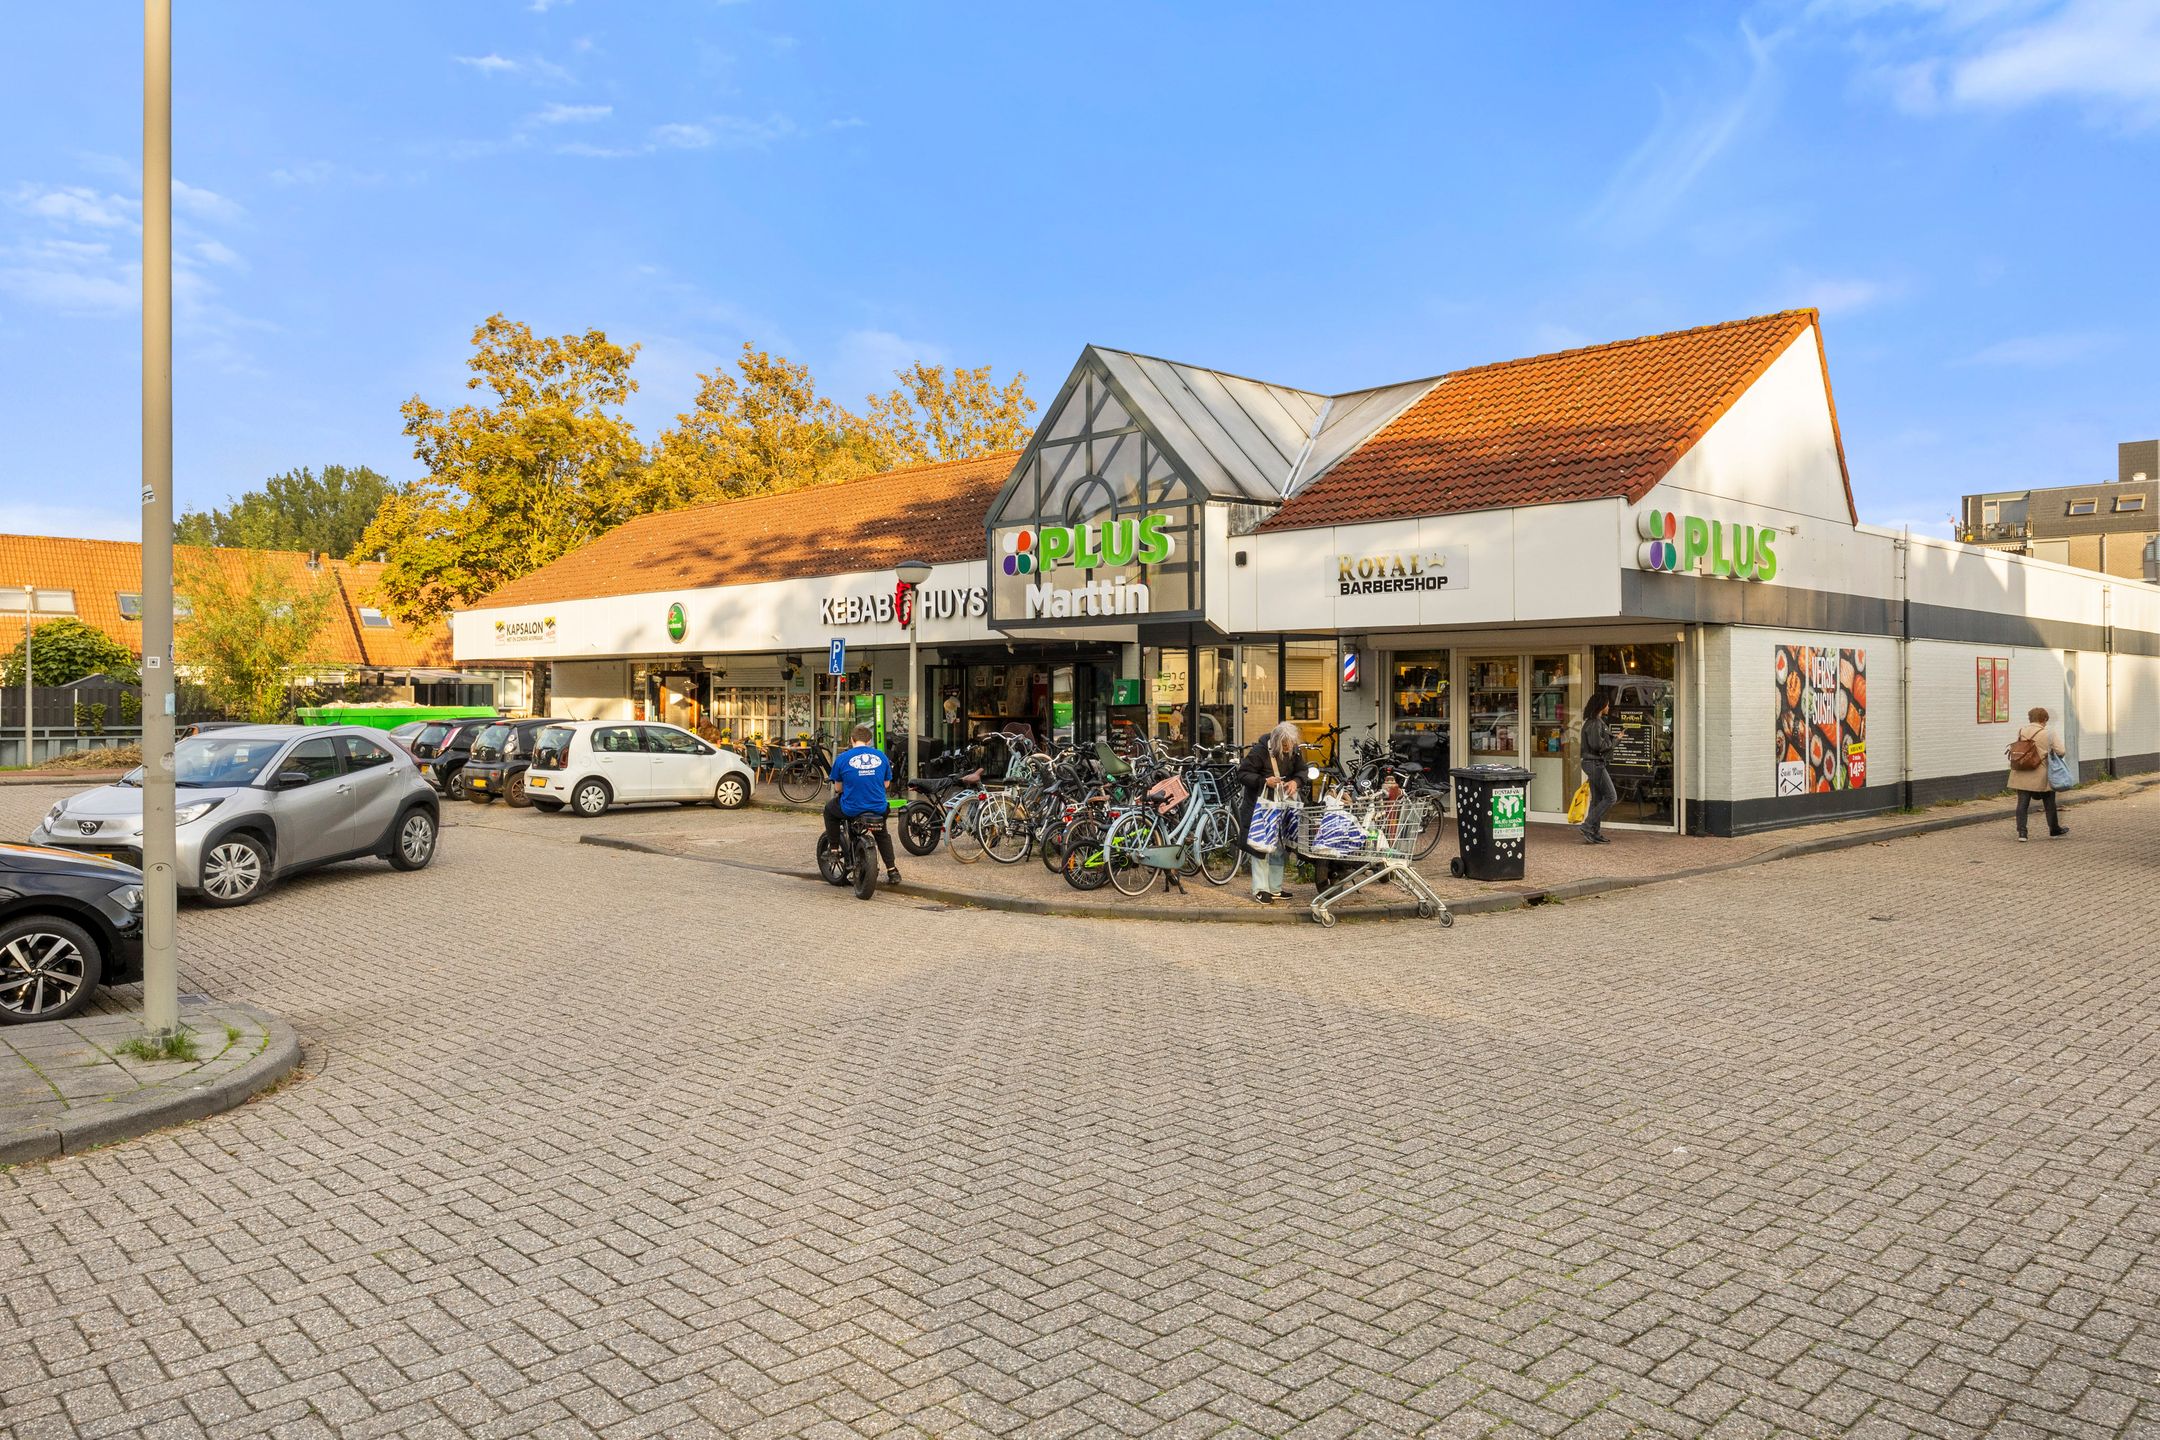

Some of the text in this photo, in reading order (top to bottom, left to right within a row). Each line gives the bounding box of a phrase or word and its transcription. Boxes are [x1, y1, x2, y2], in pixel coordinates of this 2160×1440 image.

[1039, 514, 1175, 572] PLUS
[1684, 515, 1777, 582] PLUS
[1337, 554, 1424, 582] ROYAL
[1026, 576, 1149, 619] Marttin
[1340, 576, 1448, 596] BARBERSHOP
[819, 585, 988, 625] KEBAB HUYS
[507, 621, 543, 635] KAPSALON
[832, 641, 841, 660] P
[1811, 656, 1836, 689] VERSE
[1812, 692, 1835, 725] SUSHI
